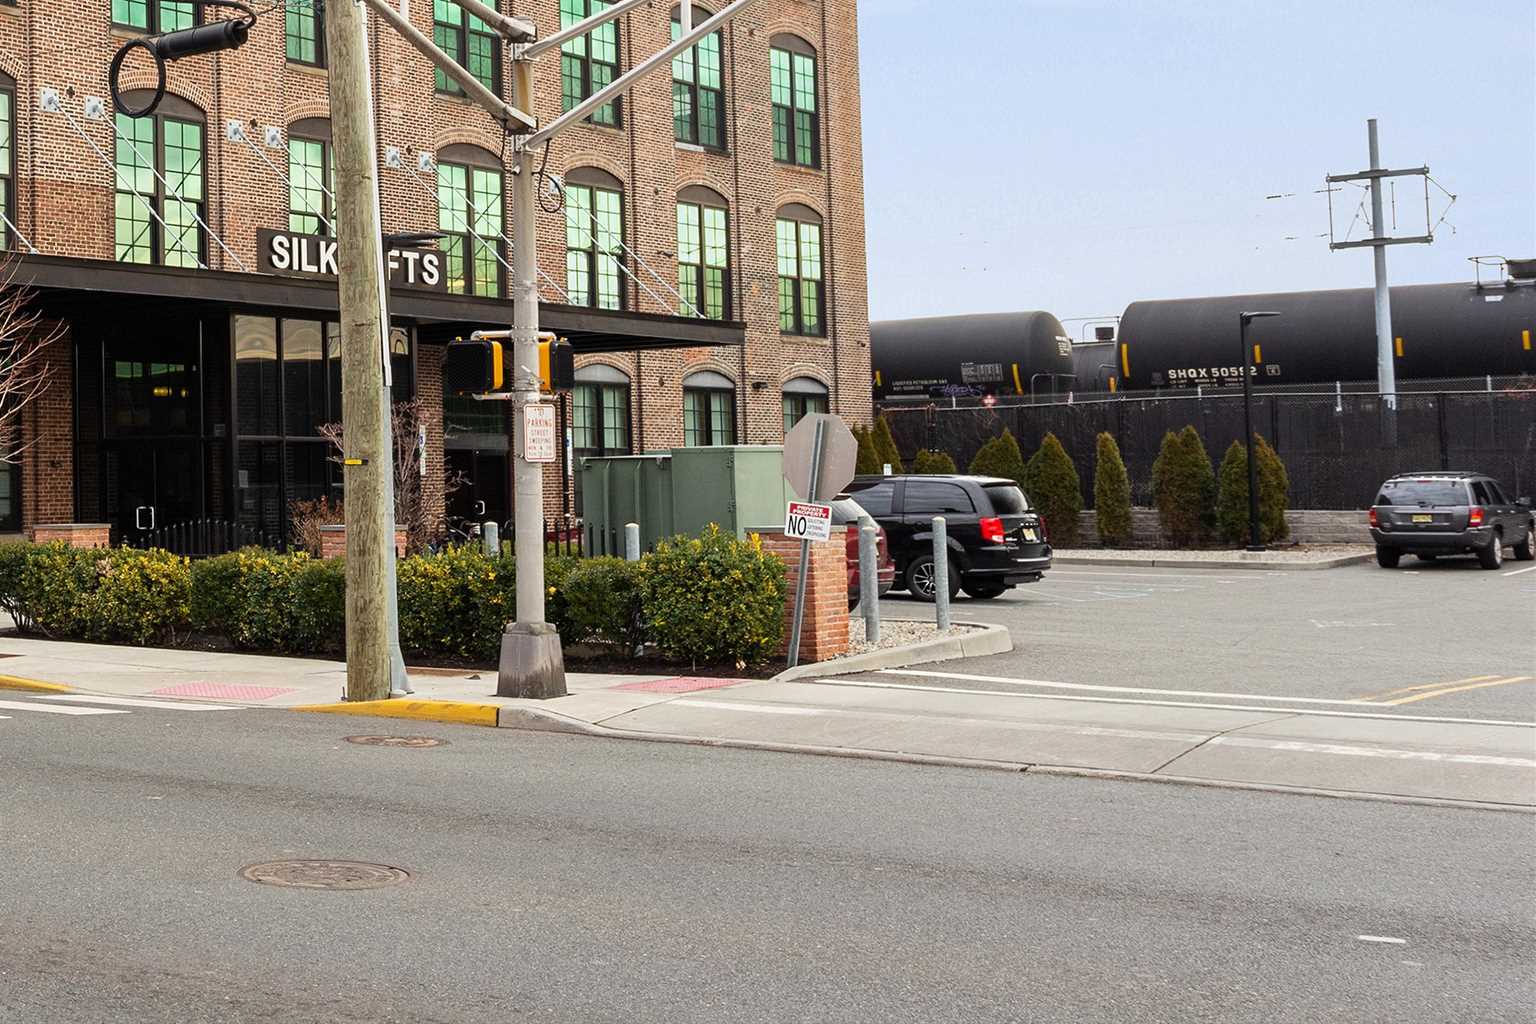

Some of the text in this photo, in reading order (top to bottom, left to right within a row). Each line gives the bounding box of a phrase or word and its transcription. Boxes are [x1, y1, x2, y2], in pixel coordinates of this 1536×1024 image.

[271, 234, 440, 286] SILKFTS
[1167, 367, 1209, 379] SHQX
[787, 515, 807, 536] NO
